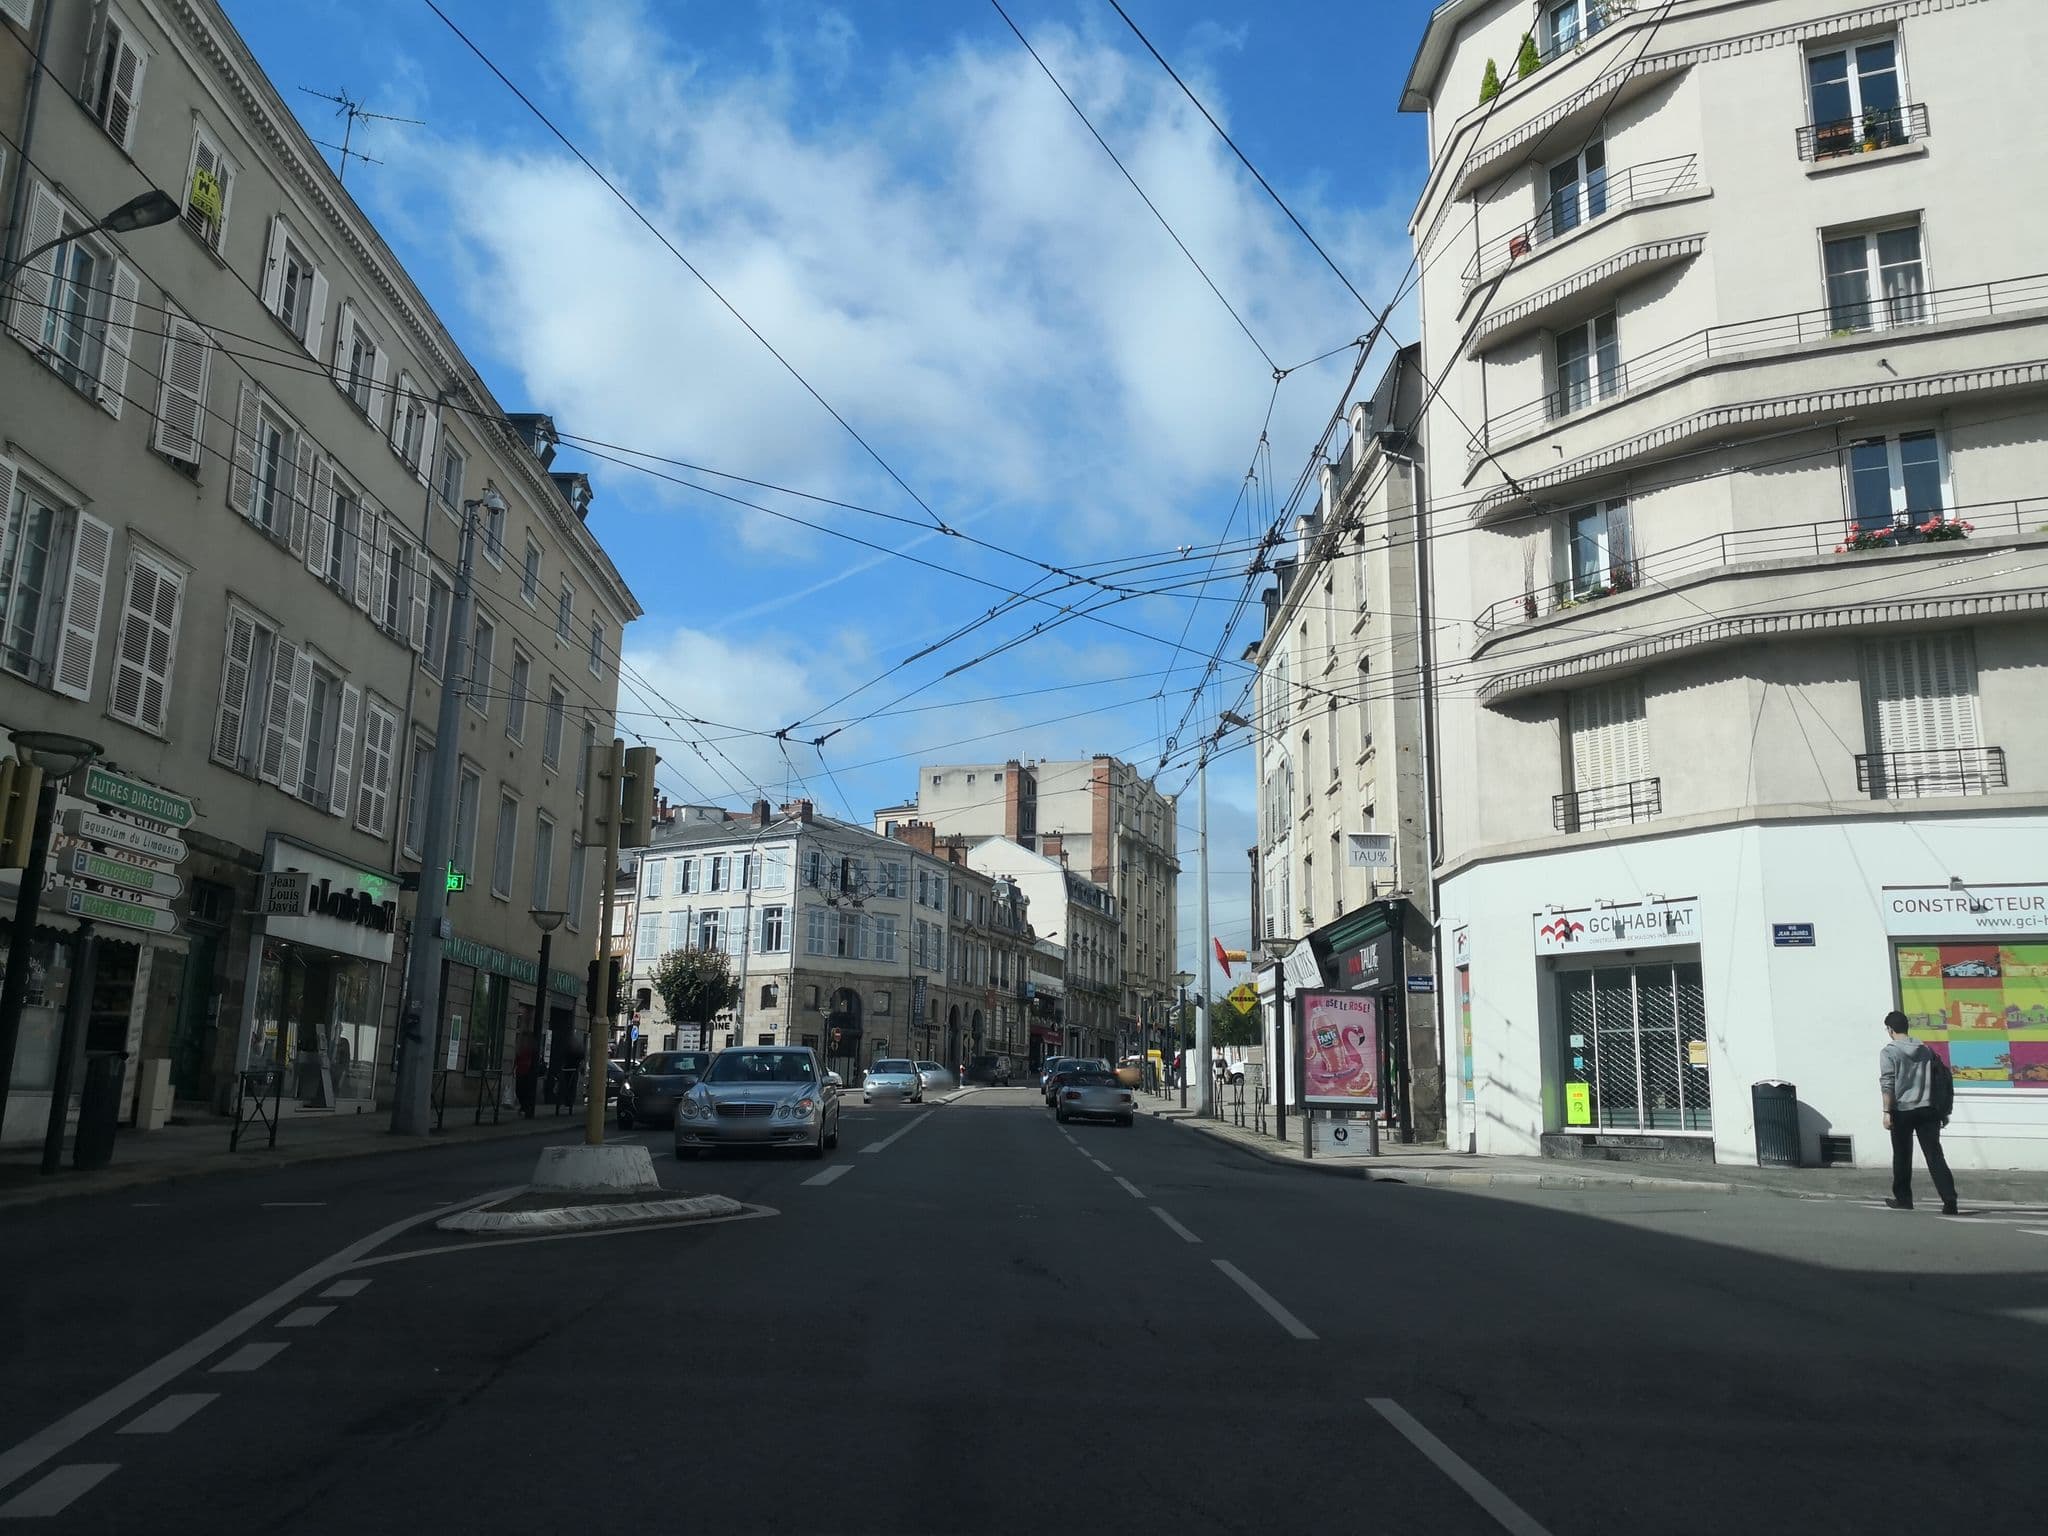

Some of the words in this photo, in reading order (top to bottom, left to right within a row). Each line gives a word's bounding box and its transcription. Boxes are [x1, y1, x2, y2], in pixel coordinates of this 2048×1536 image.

[91, 776, 128, 801] AUTRES
[131, 788, 185, 820] DIRECTIONS
[84, 820, 126, 841] aquarium
[130, 831, 140, 845] du
[1352, 850, 1387, 863] TAU%
[271, 875, 296, 888] Jean
[269, 887, 300, 900] Louis
[267, 900, 299, 913] David
[1893, 896, 2045, 913] CONSTRUCTEUR
[1623, 909, 1693, 931] HABITAT
